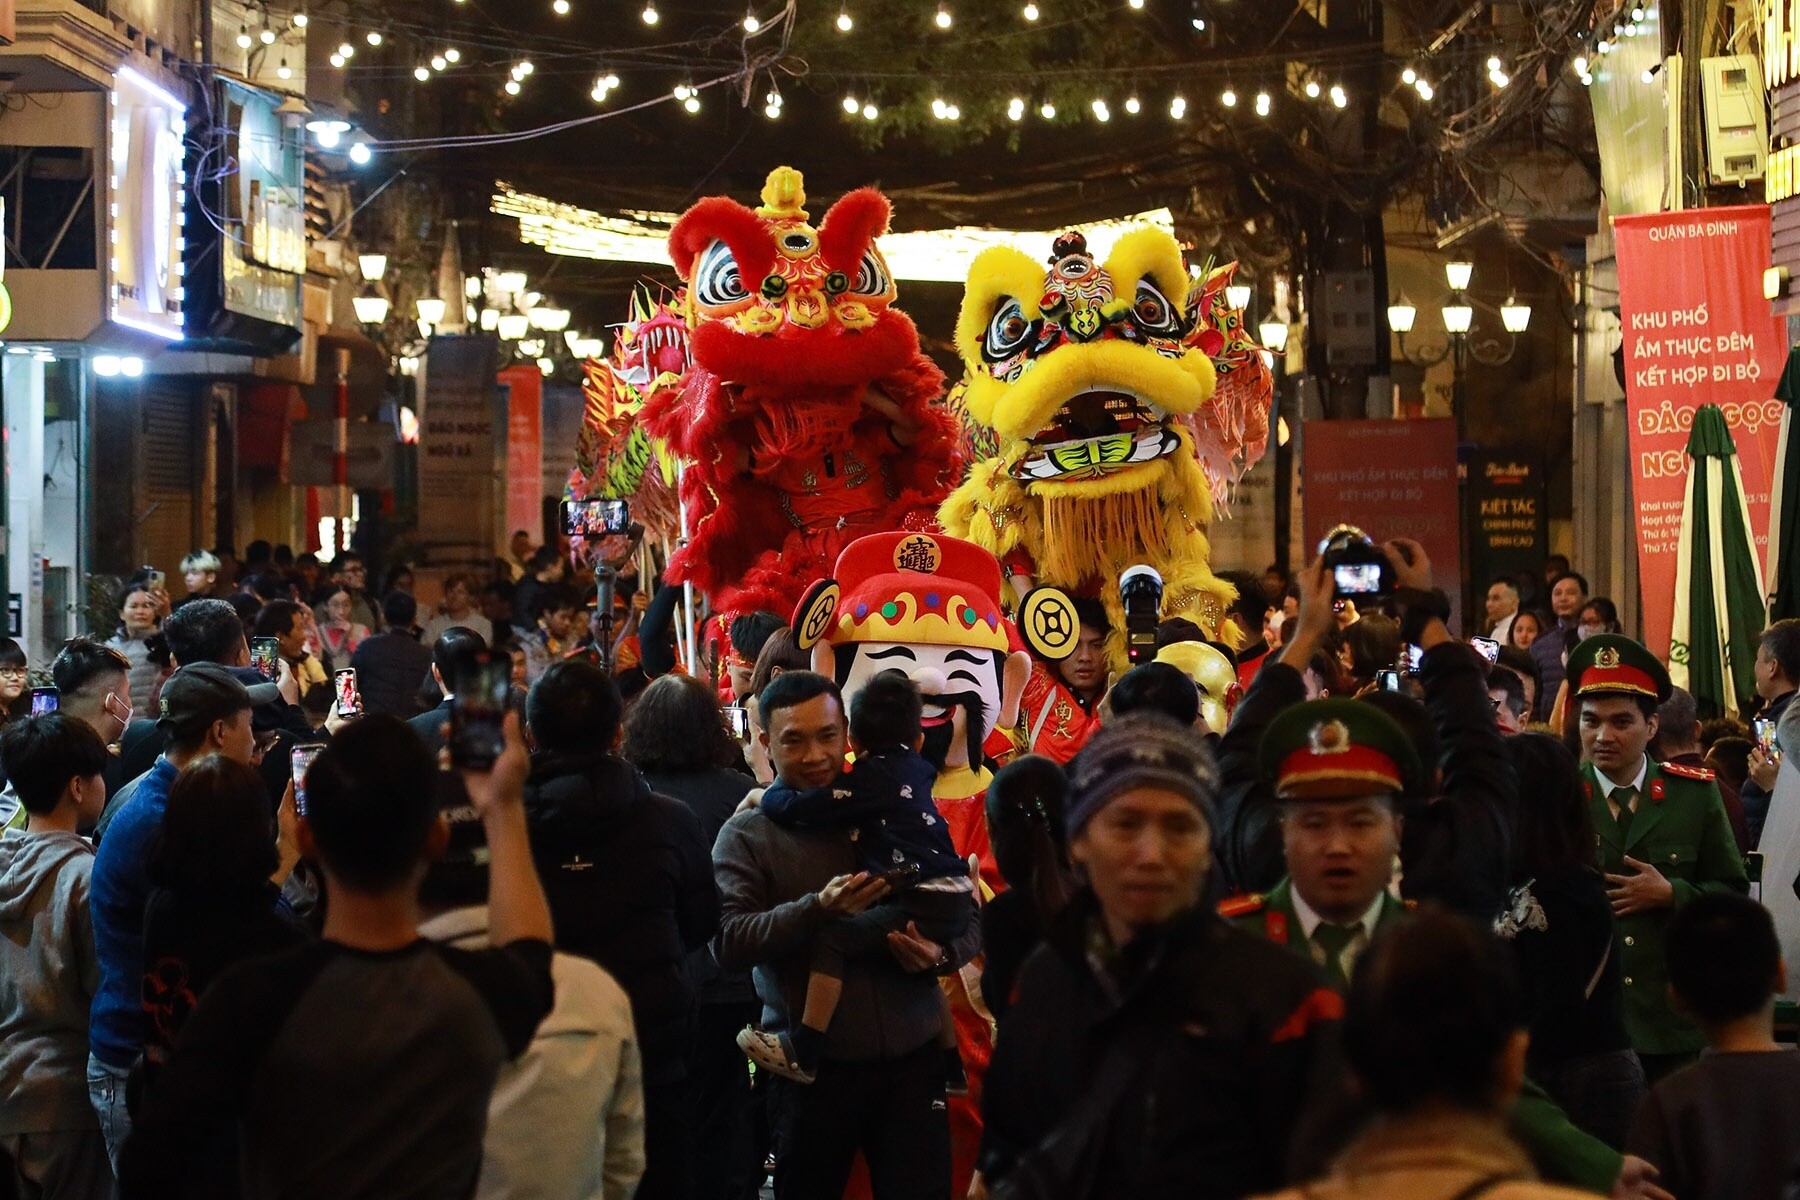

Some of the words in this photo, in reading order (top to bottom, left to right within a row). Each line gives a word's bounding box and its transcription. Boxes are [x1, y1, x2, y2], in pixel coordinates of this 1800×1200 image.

[1688, 223, 1704, 238] BA
[1707, 221, 1738, 236] ĐÌNH
[1632, 311, 1667, 330] KHU
[1672, 302, 1708, 326] PHỐ
[1634, 336, 1661, 359] ẨM
[1665, 336, 1711, 359] THỰC
[1716, 331, 1754, 353] ĐÊM
[1636, 364, 1667, 388] KẾT
[1671, 364, 1708, 388] HỢP
[1712, 364, 1731, 382] ĐI
[1735, 358, 1760, 383] BỘ
[1718, 399, 1782, 434] GỌC
[1665, 513, 1683, 525] độn
